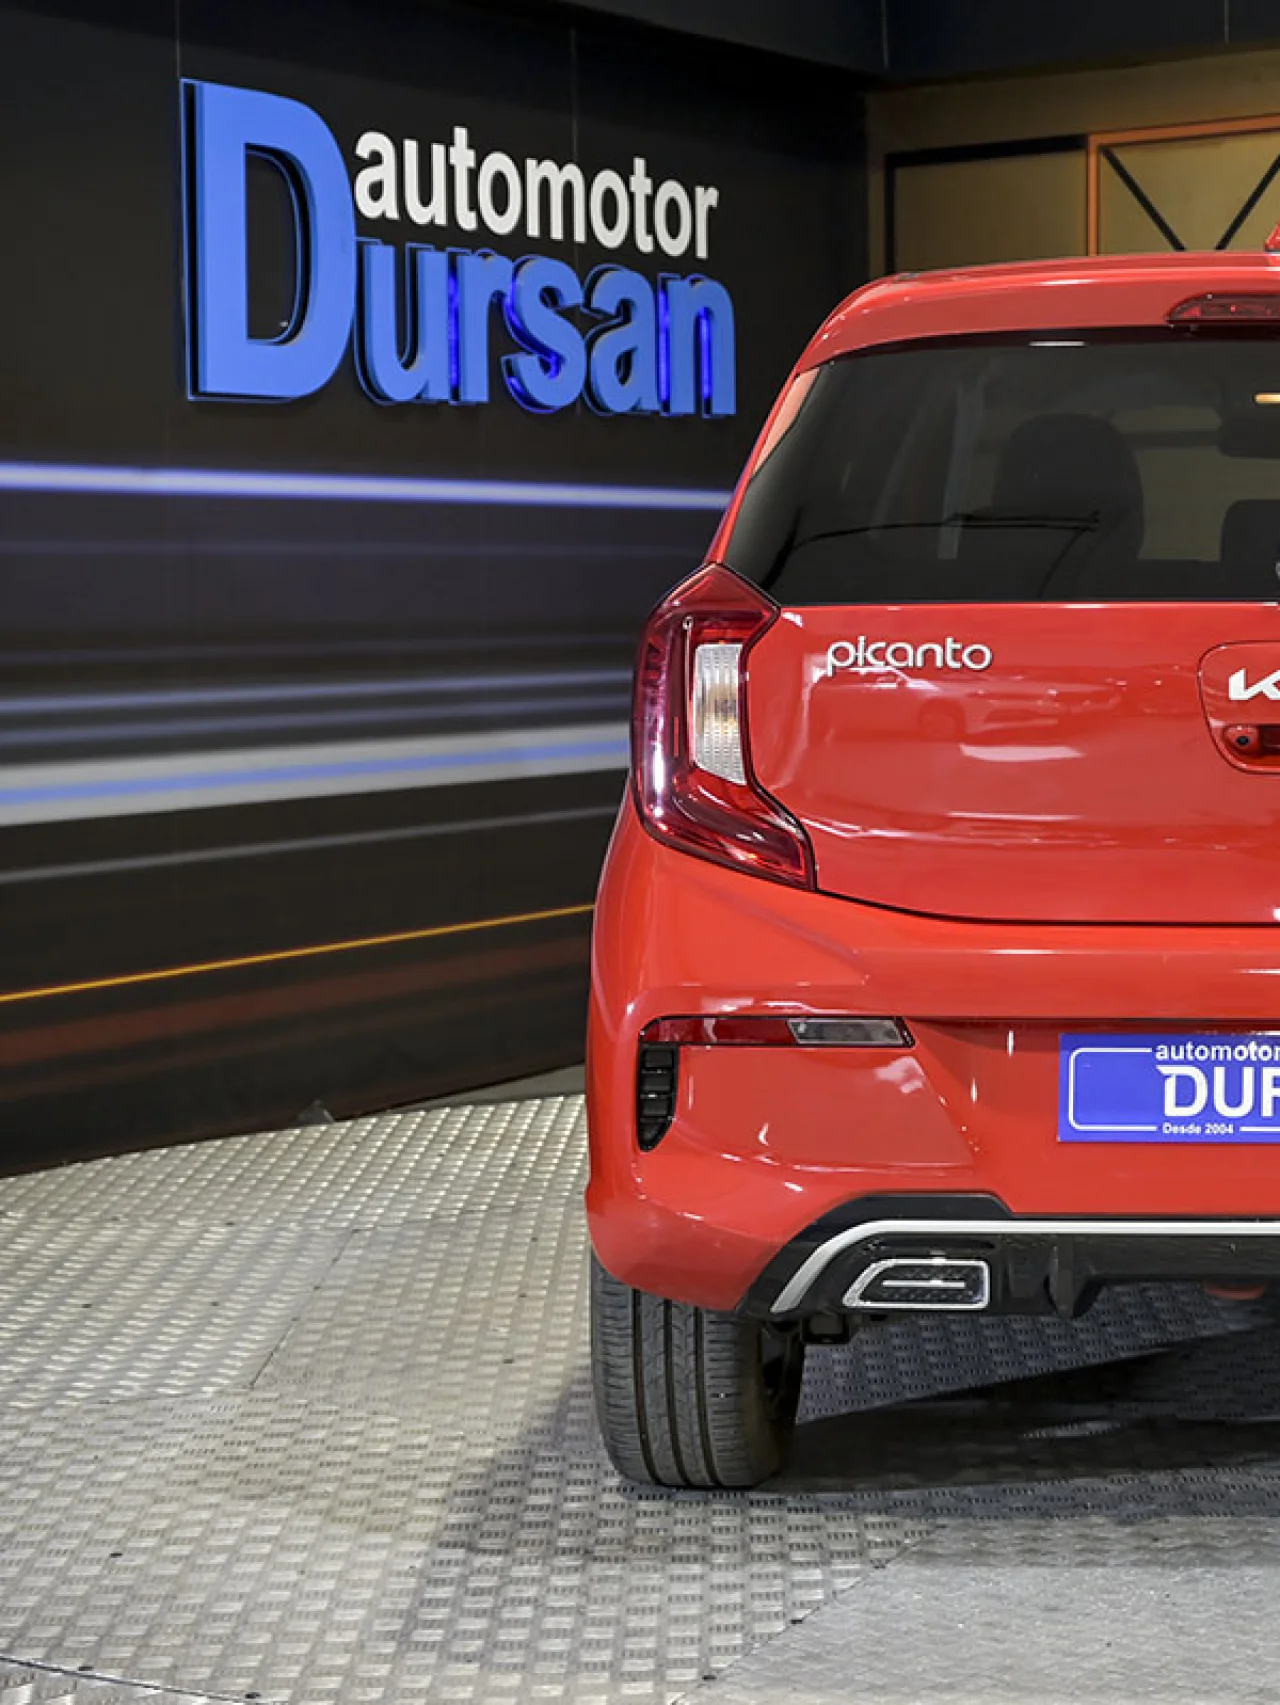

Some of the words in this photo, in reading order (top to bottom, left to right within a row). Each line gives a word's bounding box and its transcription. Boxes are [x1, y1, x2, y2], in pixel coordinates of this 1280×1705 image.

[354, 126, 719, 259] automotor
[181, 78, 736, 418] Dursan
[827, 635, 992, 677] picanto
[1162, 1121, 1201, 1134] Desde
[1204, 1122, 1233, 1134] 2004
